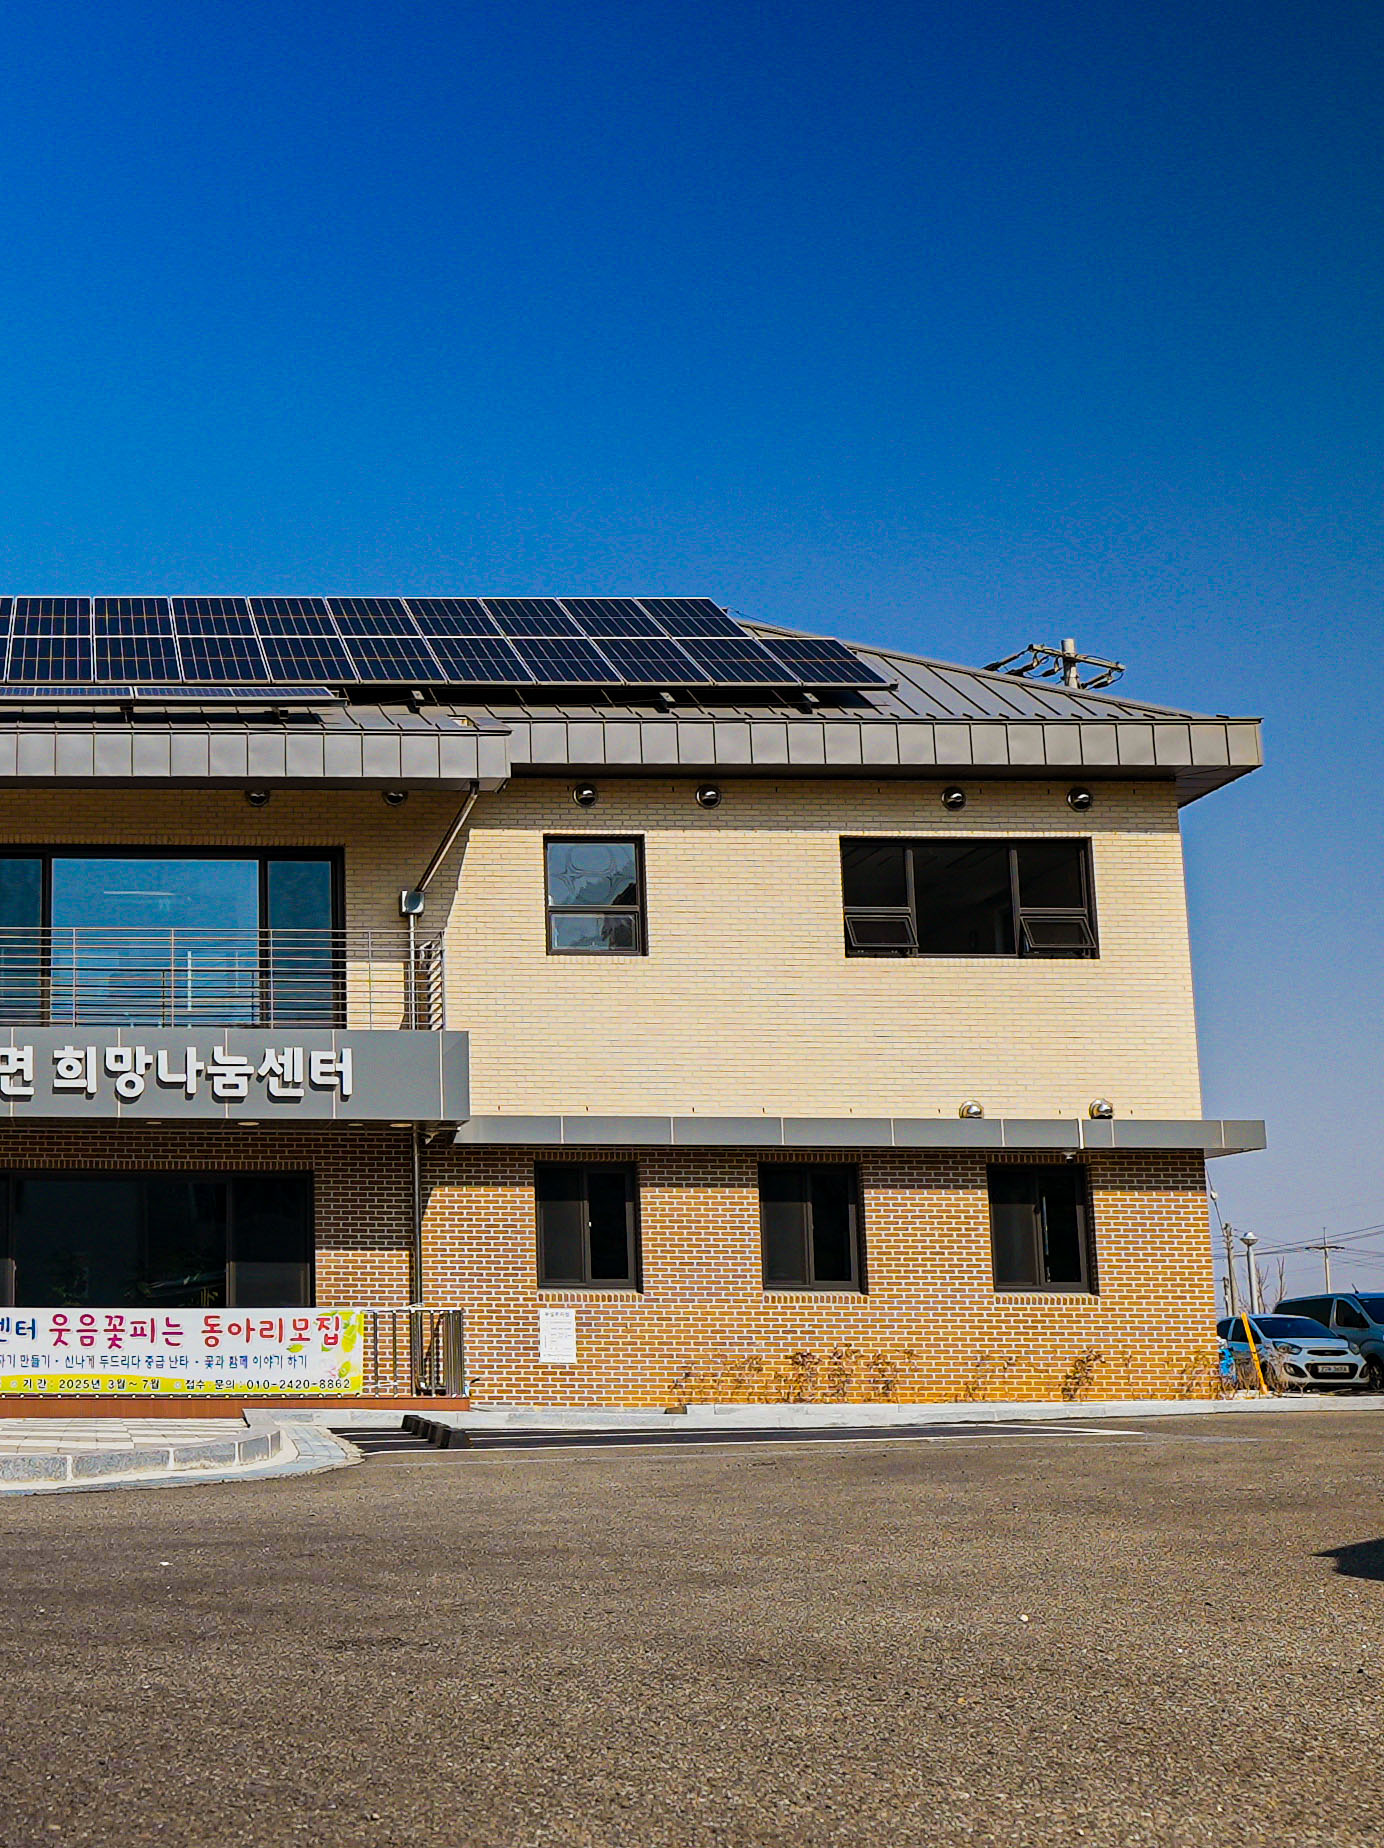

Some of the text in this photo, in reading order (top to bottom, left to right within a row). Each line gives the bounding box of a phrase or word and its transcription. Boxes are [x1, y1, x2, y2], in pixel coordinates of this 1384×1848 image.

[52, 1044, 353, 1098] 희망나눔센터
[48, 1313, 184, 1349] 웃음꽃피는
[201, 1315, 340, 1348] 동아리모집
[20, 1354, 50, 1368] 만들기
[65, 1354, 95, 1369] 신나게
[100, 1354, 141, 1369] 두드리다
[169, 1354, 189, 1369] 난타
[204, 1355, 224, 1369] 꽃과
[252, 1355, 283, 1369] 이야기
[287, 1355, 307, 1369] 하기
[59, 1378, 101, 1390] 2025년
[142, 1379, 160, 1390] 7월
[246, 1379, 351, 1391] 010-2420-8862
